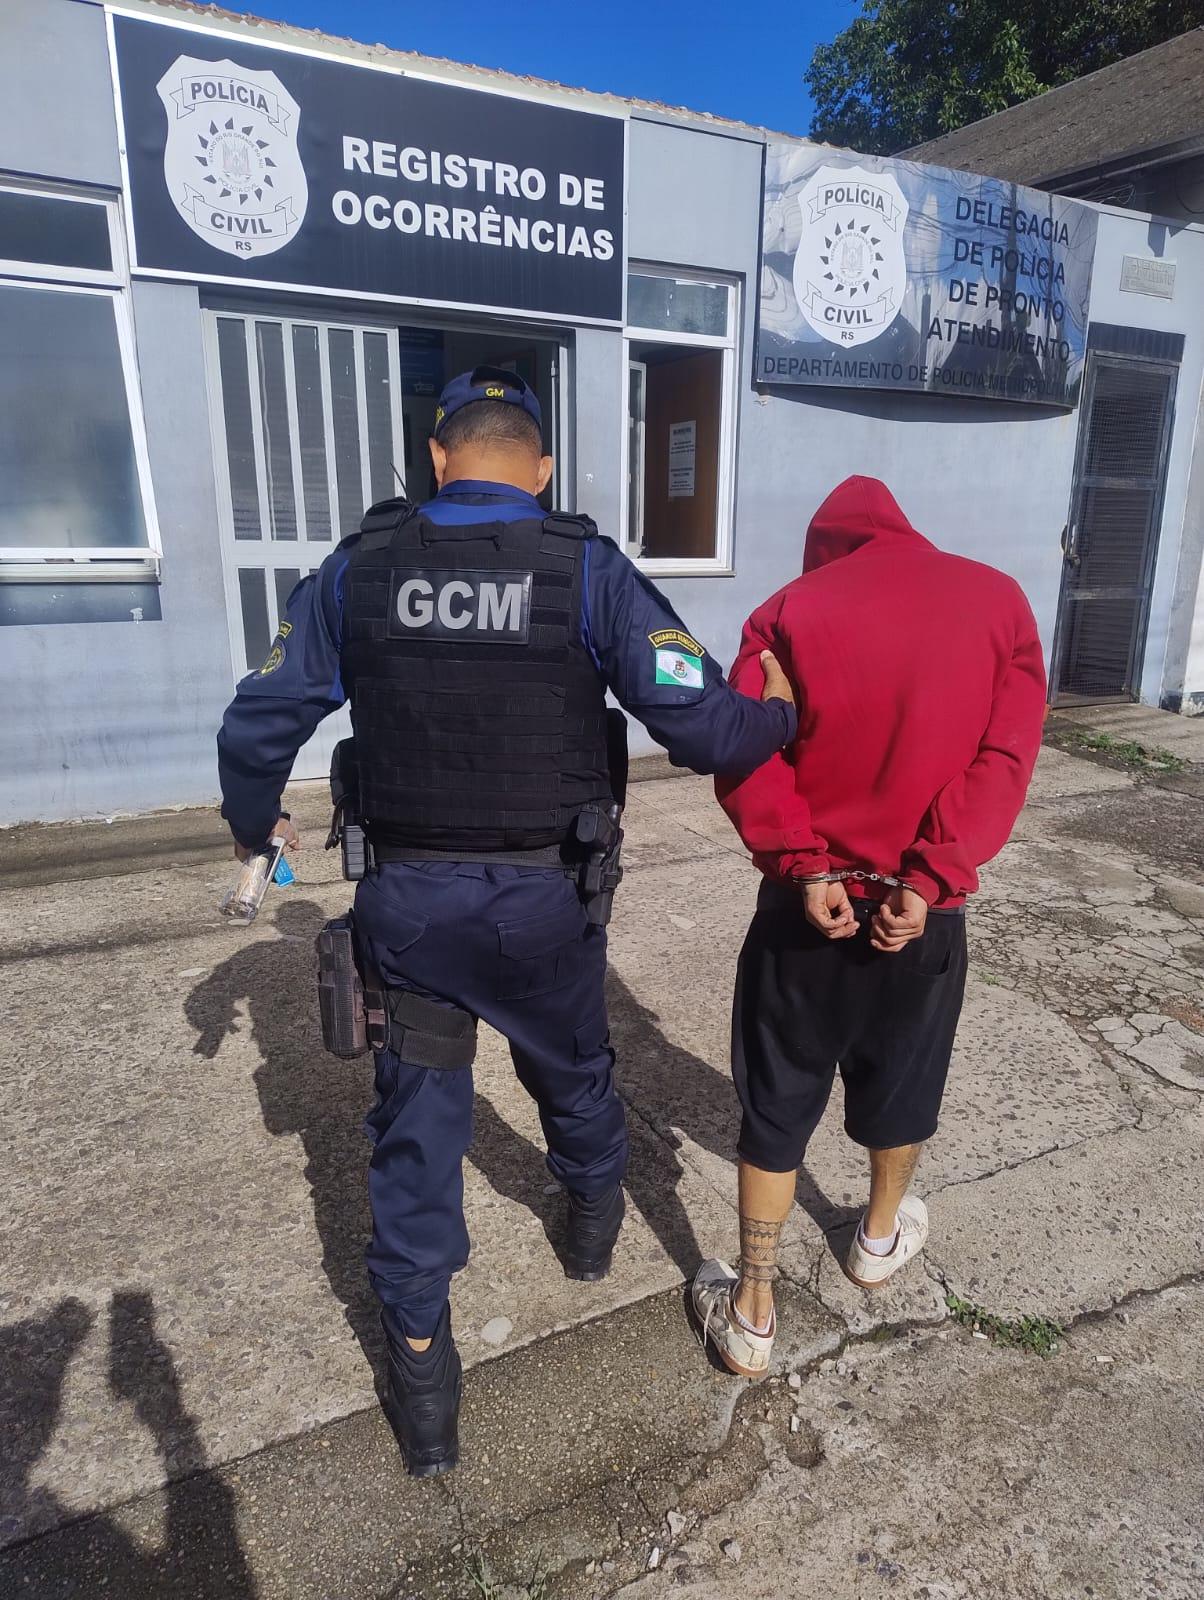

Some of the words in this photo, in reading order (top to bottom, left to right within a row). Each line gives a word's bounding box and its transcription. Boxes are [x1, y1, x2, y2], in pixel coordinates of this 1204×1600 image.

[191, 80, 269, 113] POLÍCIA
[343, 135, 546, 200] REGISTRO
[560, 173, 604, 210] DE
[825, 184, 884, 212] POLÍCIA
[210, 213, 272, 234] CIVIL
[332, 190, 614, 260] OCORRÊNCIAS
[956, 196, 1069, 246] DELEGACIA
[235, 241, 252, 251] RS
[954, 238, 984, 266] DE
[991, 245, 1065, 285] POLÍCIA
[824, 306, 872, 324] CIVIL
[949, 279, 978, 306] DE
[985, 286, 1064, 322] PRONTO
[841, 331, 854, 340] RS
[927, 317, 1070, 361] ATENDIMENTO
[764, 356, 903, 381] DEPARTAMENTO
[908, 365, 928, 382] DE
[486, 387, 504, 398] GM
[397, 578, 523, 632] GCM
